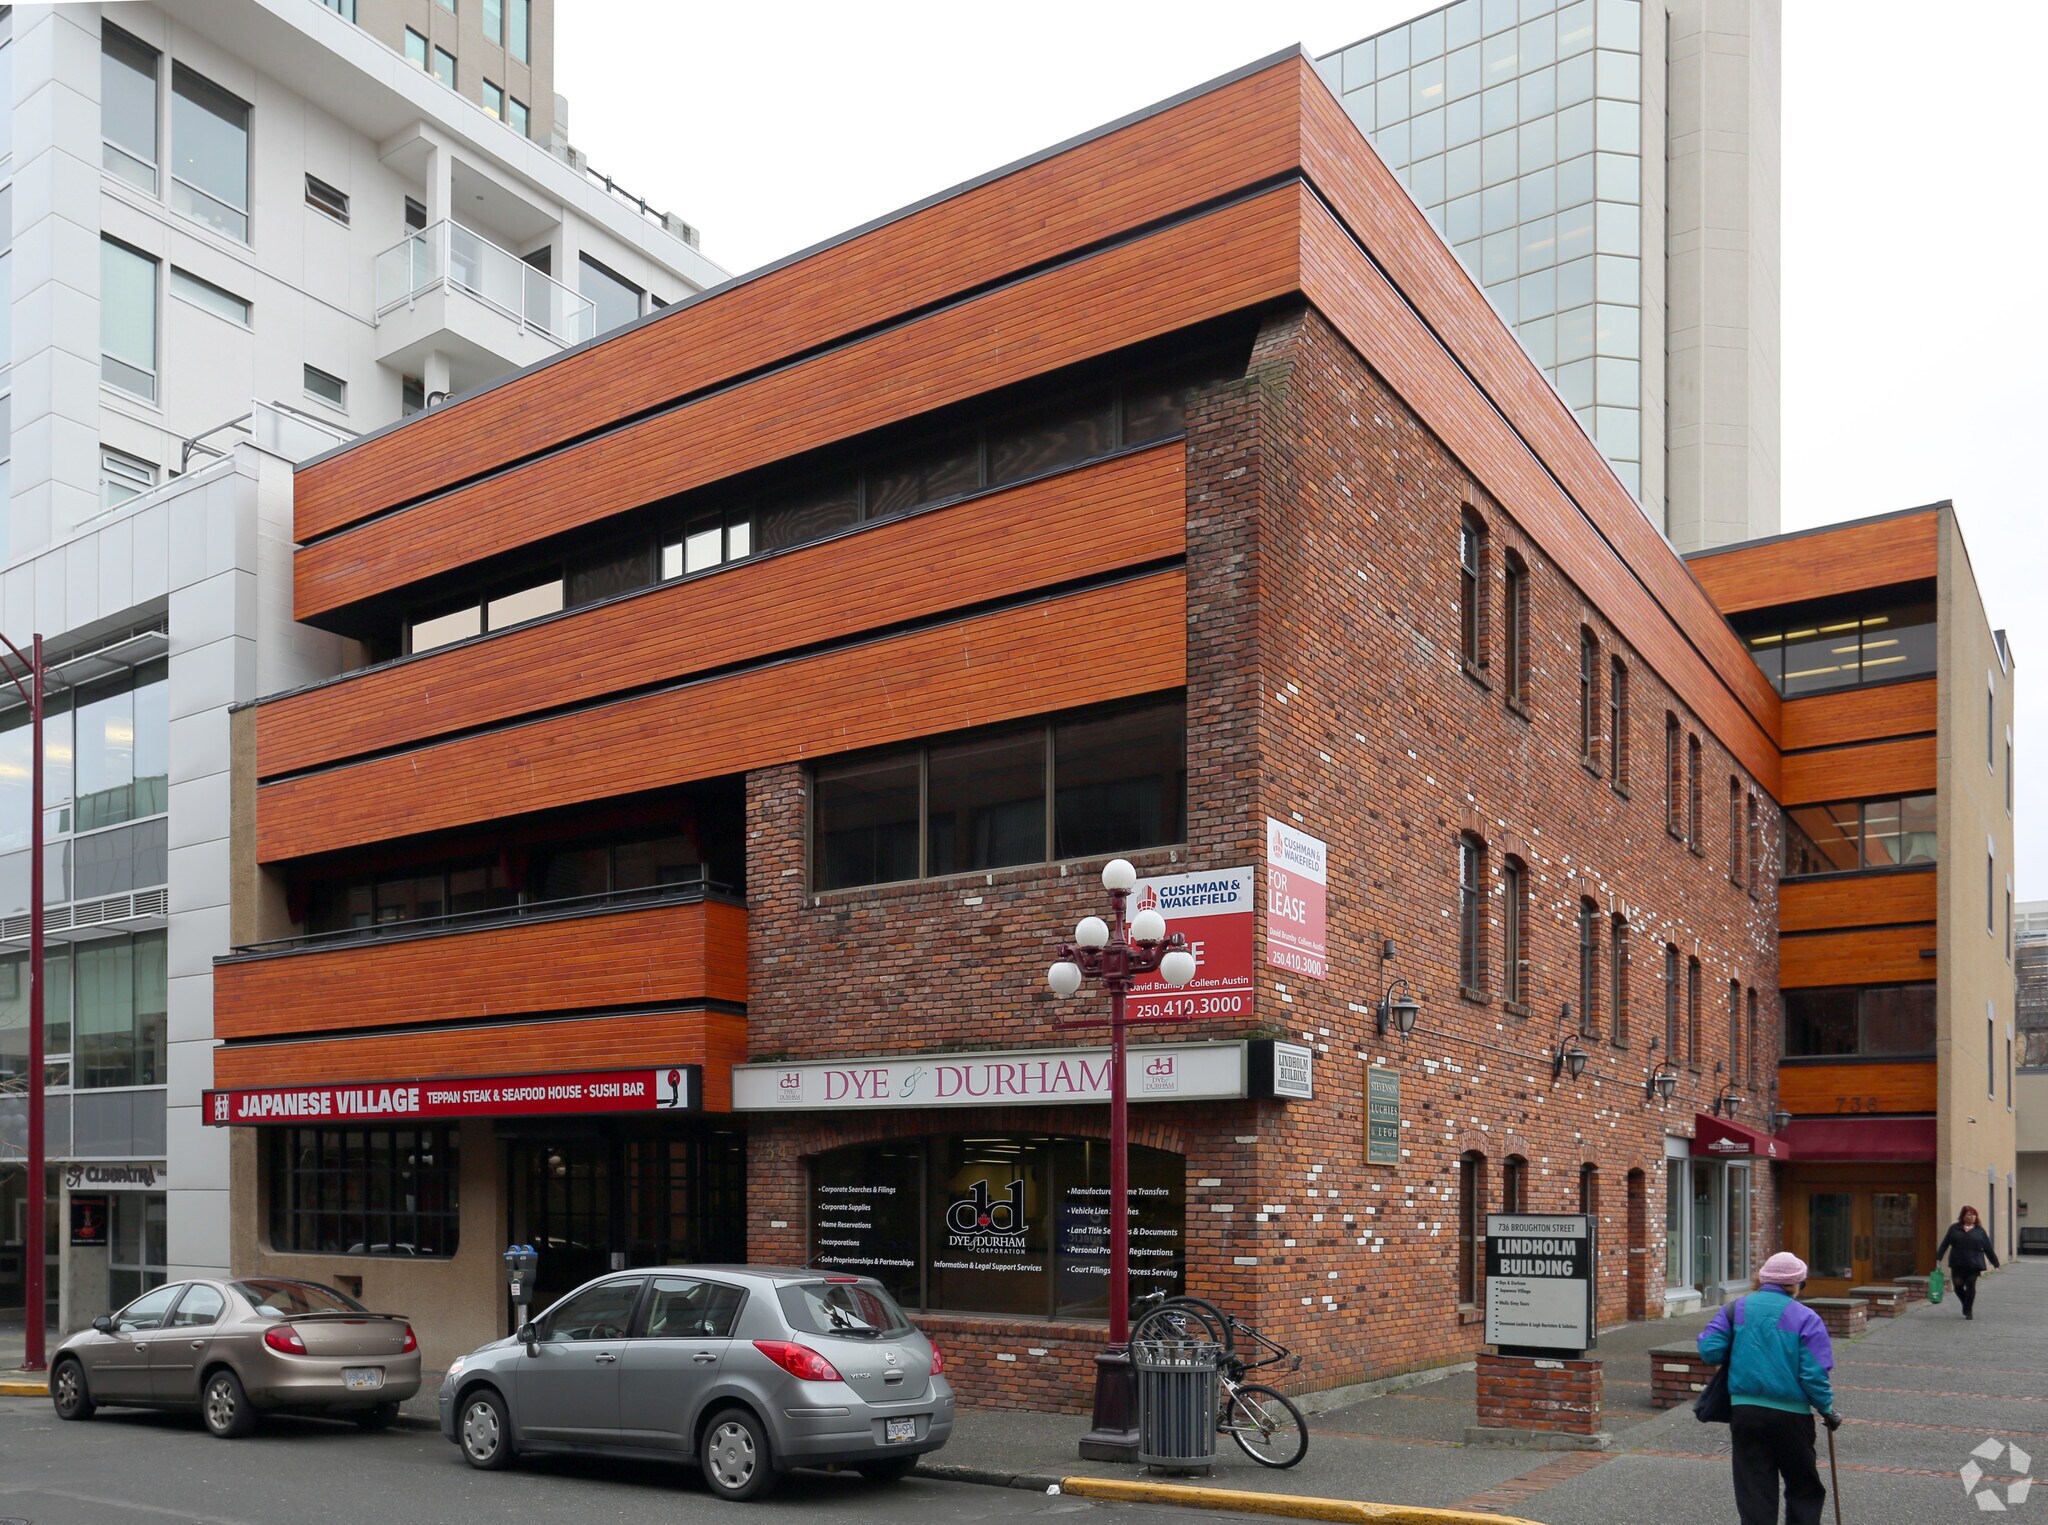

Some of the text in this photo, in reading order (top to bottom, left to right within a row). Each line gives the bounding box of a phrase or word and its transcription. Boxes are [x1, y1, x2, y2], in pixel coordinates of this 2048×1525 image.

[1284, 836, 1320, 861] CUSHMAN &
[1284, 848, 1320, 872] WAKEFIELD
[1268, 869, 1288, 892] FOR
[1160, 880, 1240, 897] CUSHMAN &
[1160, 891, 1238, 909] WAKEFIELD
[1268, 888, 1306, 924] LEASE
[1270, 927, 1281, 936] David
[1282, 930, 1297, 944] Brumby
[1272, 950, 1322, 976] 250.410.3000
[1190, 979, 1220, 988] Colleen
[1222, 976, 1249, 985] Austin
[1137, 996, 1242, 1017] 250.410.3000
[1278, 1054, 1308, 1070] LINDHOLM
[823, 1060, 1112, 1101] DYE & DURHAM
[1280, 1068, 1307, 1082] BUILDING
[238, 1082, 645, 1118] JAPANESE VILLAGE TEPPAN STEAK & SEAFOOD HOUSE SUSHI BAR
[1836, 1096, 1878, 1113] 736
[1370, 1104, 1398, 1116] LUCHIES
[1378, 1128, 1397, 1138] LEGH
[86, 1164, 156, 1188] CLEOPATRA
[821, 1186, 848, 1194] Corporate
[878, 1186, 896, 1194] Filings
[1138, 1188, 1170, 1196] Transfers
[821, 1203, 871, 1212] Corporate Supplies
[1071, 1207, 1094, 1215] Vehicle
[1094, 1207, 1108, 1215] Lien
[1070, 1226, 1088, 1234] Land
[1088, 1226, 1102, 1234] Title
[1140, 1228, 1178, 1236] Documents
[1498, 1224, 1575, 1232] 736 BROUGHTON STREET
[821, 1238, 860, 1247] Incorporations
[949, 1236, 970, 1246] DYE
[976, 1236, 1026, 1248] DURHAM
[1498, 1239, 1576, 1256] LINDHOLM
[1070, 1246, 1099, 1254] Personal
[1129, 1248, 1174, 1257] Registrations
[833, 1257, 874, 1266] Proprietorships
[879, 1258, 914, 1268] Partnerships
[934, 1260, 969, 1269] Information
[974, 1262, 991, 1271] Legal
[992, 1262, 1017, 1272] Support
[1017, 1264, 1042, 1272] Services
[1500, 1259, 1573, 1276] BUILDING
[1090, 1266, 1111, 1276] Filings
[1152, 1268, 1178, 1278] Serving
